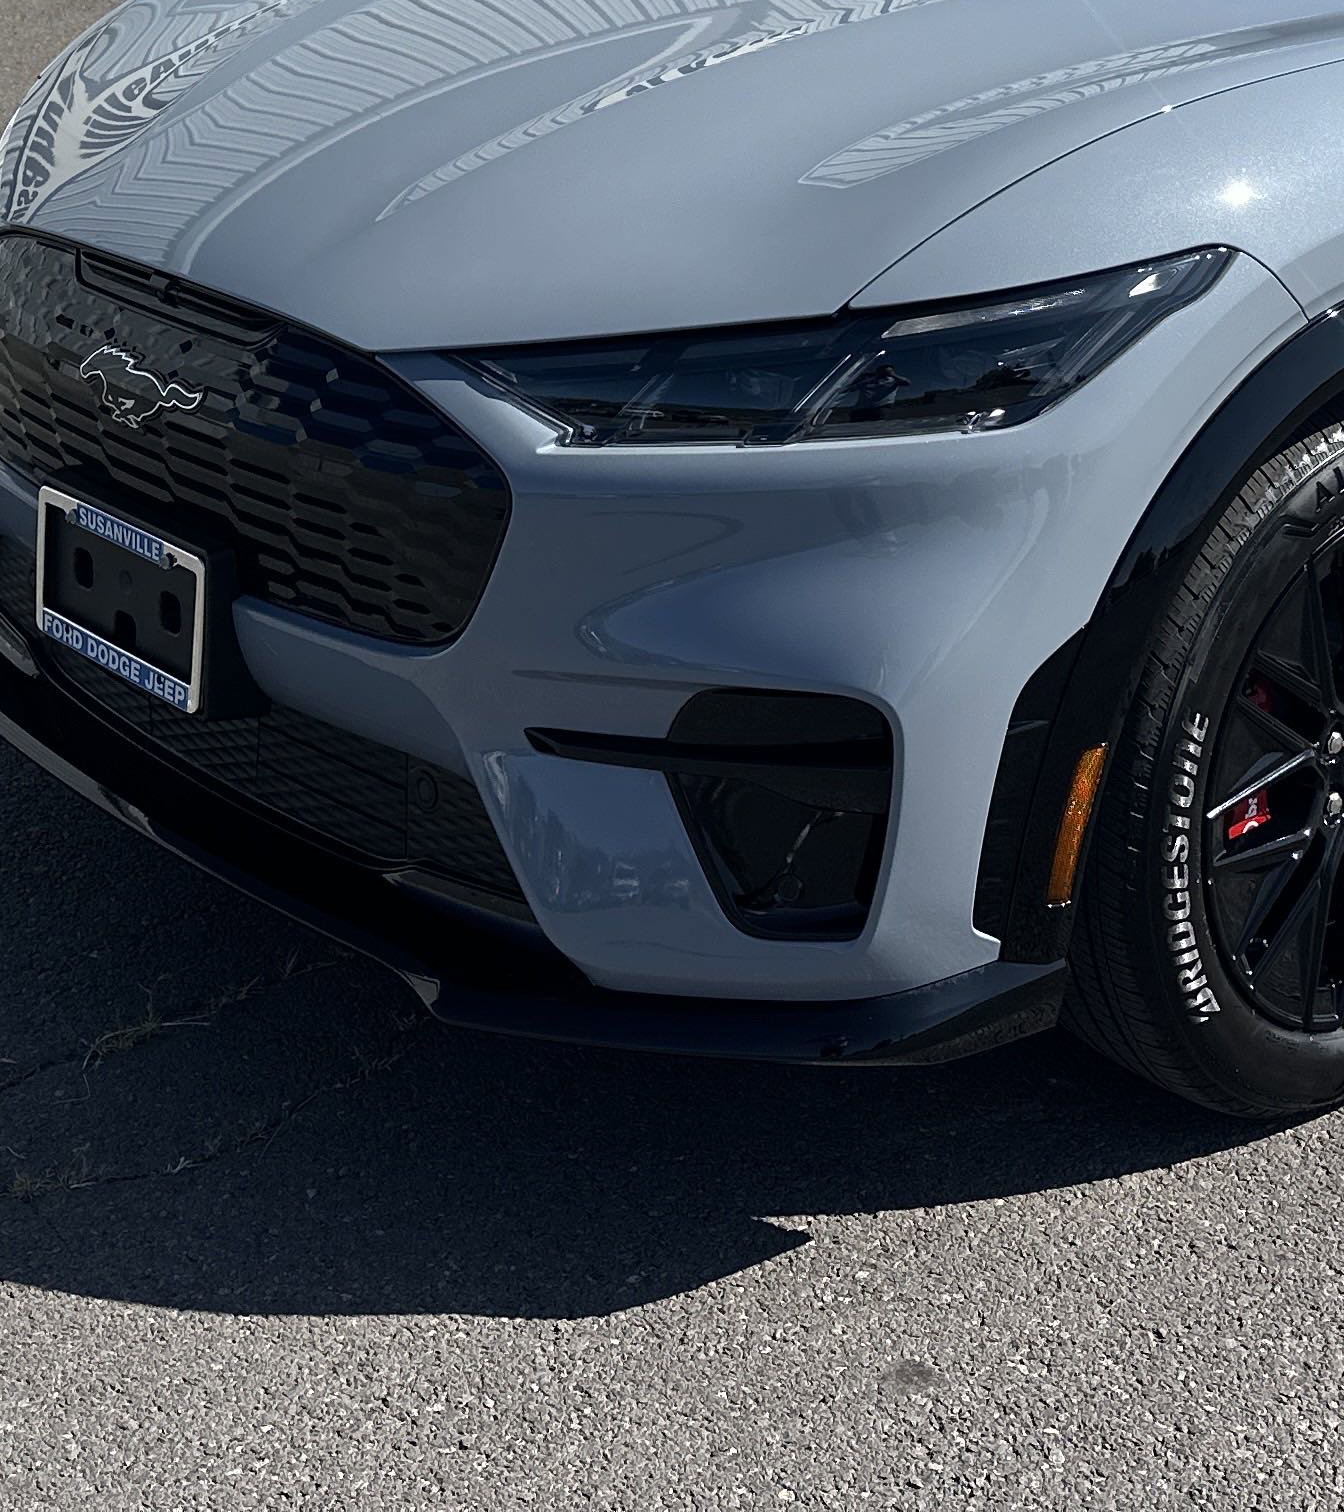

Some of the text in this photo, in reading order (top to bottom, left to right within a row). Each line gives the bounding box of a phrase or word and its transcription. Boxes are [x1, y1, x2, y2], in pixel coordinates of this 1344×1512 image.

[78, 507, 161, 561] SUSANVILLE
[44, 615, 186, 705] FORD DODGE JEEP
[1161, 711, 1221, 1023] BRIDGESTONE
